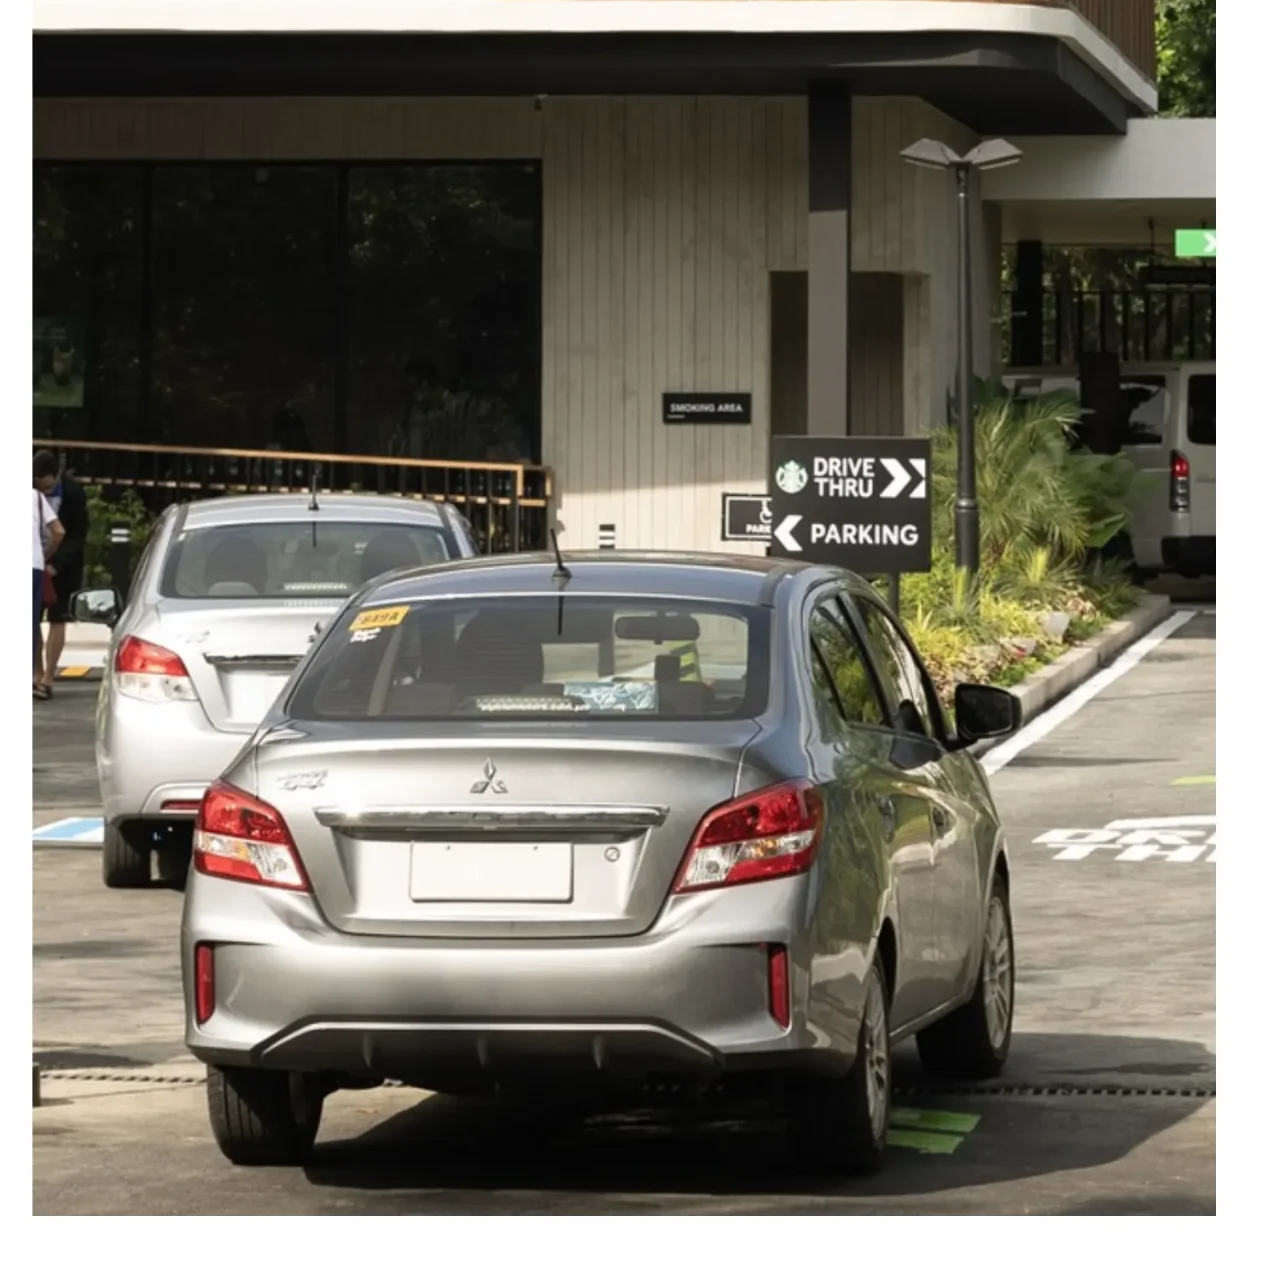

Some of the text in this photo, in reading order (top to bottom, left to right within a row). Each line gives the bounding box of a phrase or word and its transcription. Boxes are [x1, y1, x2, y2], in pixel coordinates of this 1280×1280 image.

[669, 402, 744, 413] SMOKING AREA
[813, 456, 875, 478] DRIVE
[814, 477, 874, 498] THRU
[745, 523, 772, 534] PARK
[810, 523, 919, 546] PARKING
[1032, 828, 1217, 845] DR
[1046, 844, 1216, 862] TH
